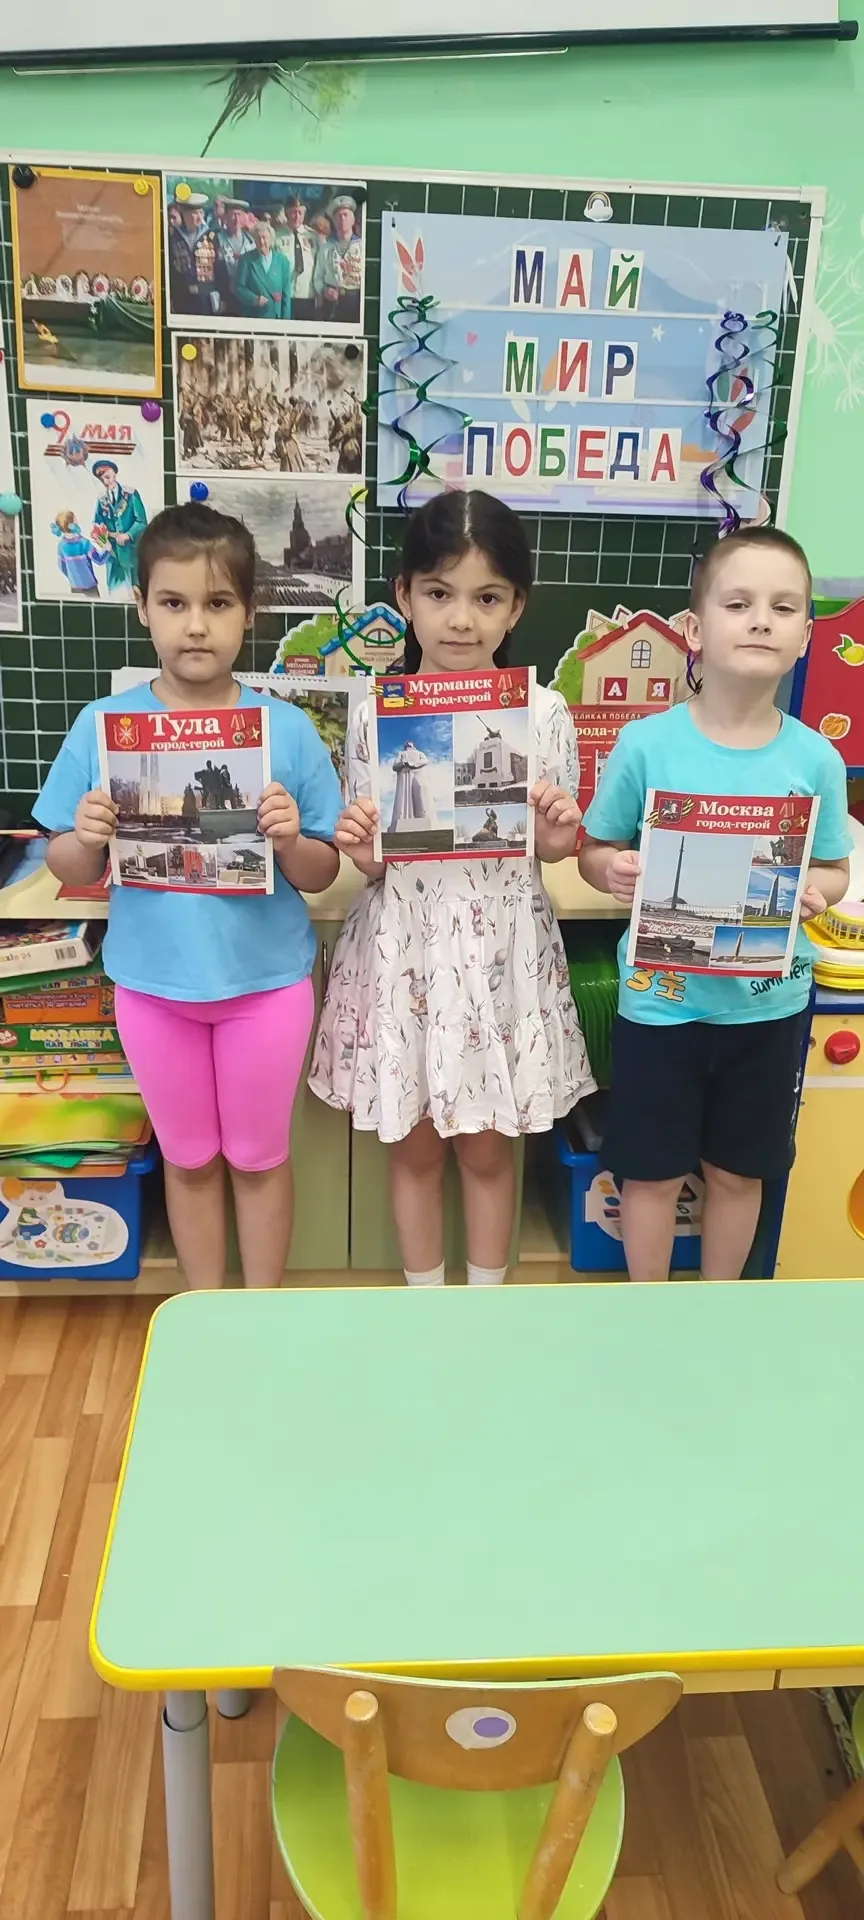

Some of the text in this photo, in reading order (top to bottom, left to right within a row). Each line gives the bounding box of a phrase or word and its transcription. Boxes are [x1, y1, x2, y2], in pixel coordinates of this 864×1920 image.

[513, 249, 640, 309] МАЙ
[505, 340, 635, 396] МИР
[52, 410, 71, 443] 9
[466, 426, 677, 482] ПОБЕДА
[408, 677, 493, 697] Мурманск
[419, 691, 492, 708] город-герой
[573, 712, 607, 720] ЕЛИКАЯ
[147, 713, 222, 741] Тула
[150, 737, 225, 751] город-герой
[697, 800, 775, 817] Москва
[696, 818, 771, 831] город-герой
[30, 1029, 114, 1041] МОЗАИКА
